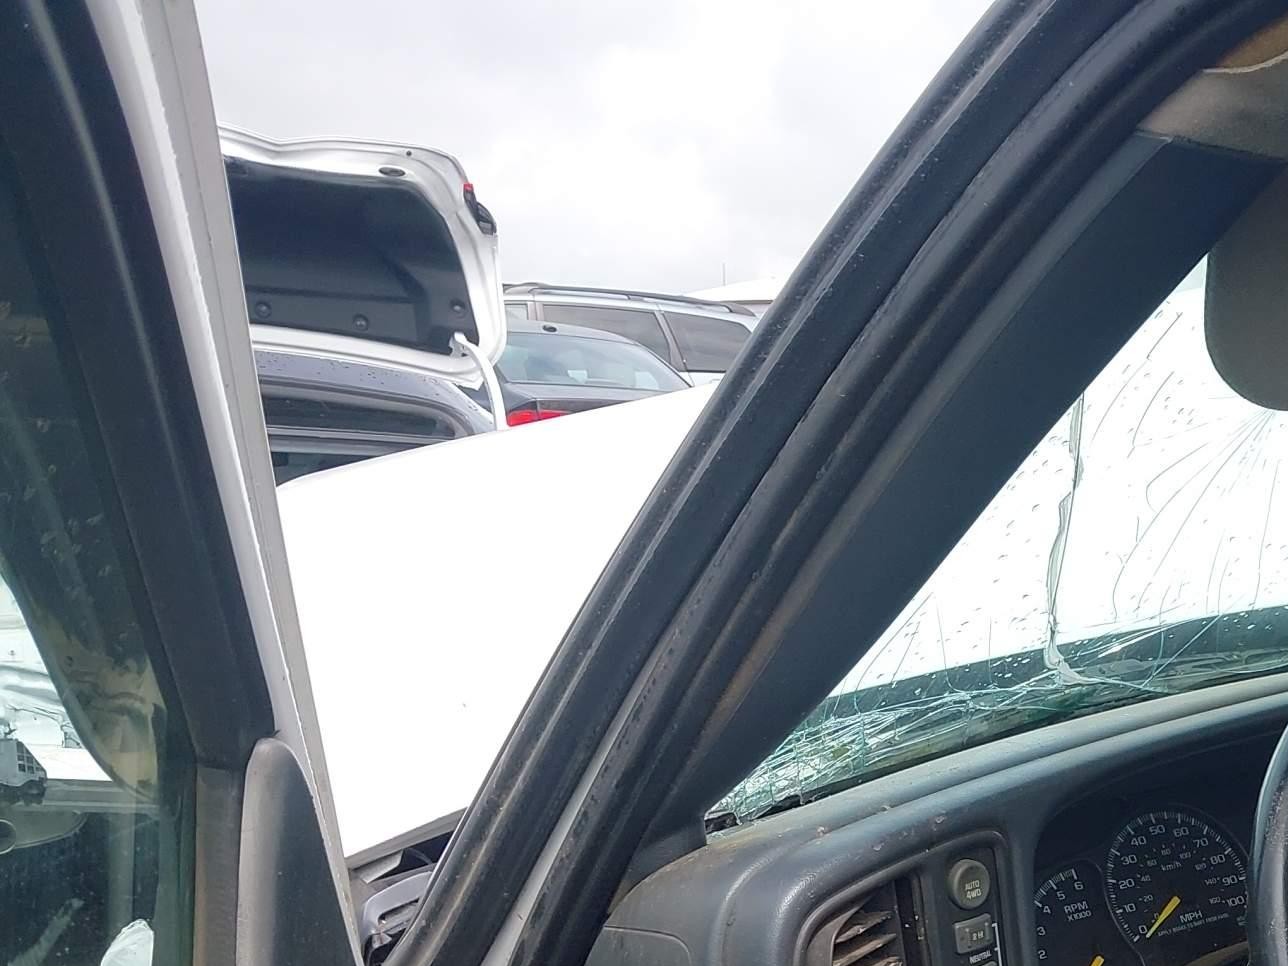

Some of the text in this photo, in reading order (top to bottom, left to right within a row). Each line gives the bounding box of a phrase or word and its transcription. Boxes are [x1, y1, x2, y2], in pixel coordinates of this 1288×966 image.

[1149, 824, 1166, 835] 50
[1173, 826, 1189, 837] 60
[1130, 836, 1147, 847] 40
[1193, 837, 1209, 848] 70
[1121, 854, 1138, 865] 30
[1210, 853, 1226, 866] 80
[1160, 861, 1182, 871] km/h
[965, 880, 980, 890] AUTO
[1118, 878, 1135, 889] 20
[1222, 874, 1238, 885] 90
[1074, 881, 1084, 890] 6
[966, 889, 981, 900] 4WD
[1057, 890, 1066, 900] 5
[1226, 895, 1245, 907] 100
[1043, 906, 1051, 914] 4
[1063, 901, 1089, 914] RPM
[1123, 903, 1136, 913] 10
[1179, 910, 1202, 924] MPH
[1037, 927, 1046, 936] 3
[1138, 924, 1147, 934] 0
[969, 950, 992, 964] NEUTRAL
[1038, 950, 1048, 959] 2
